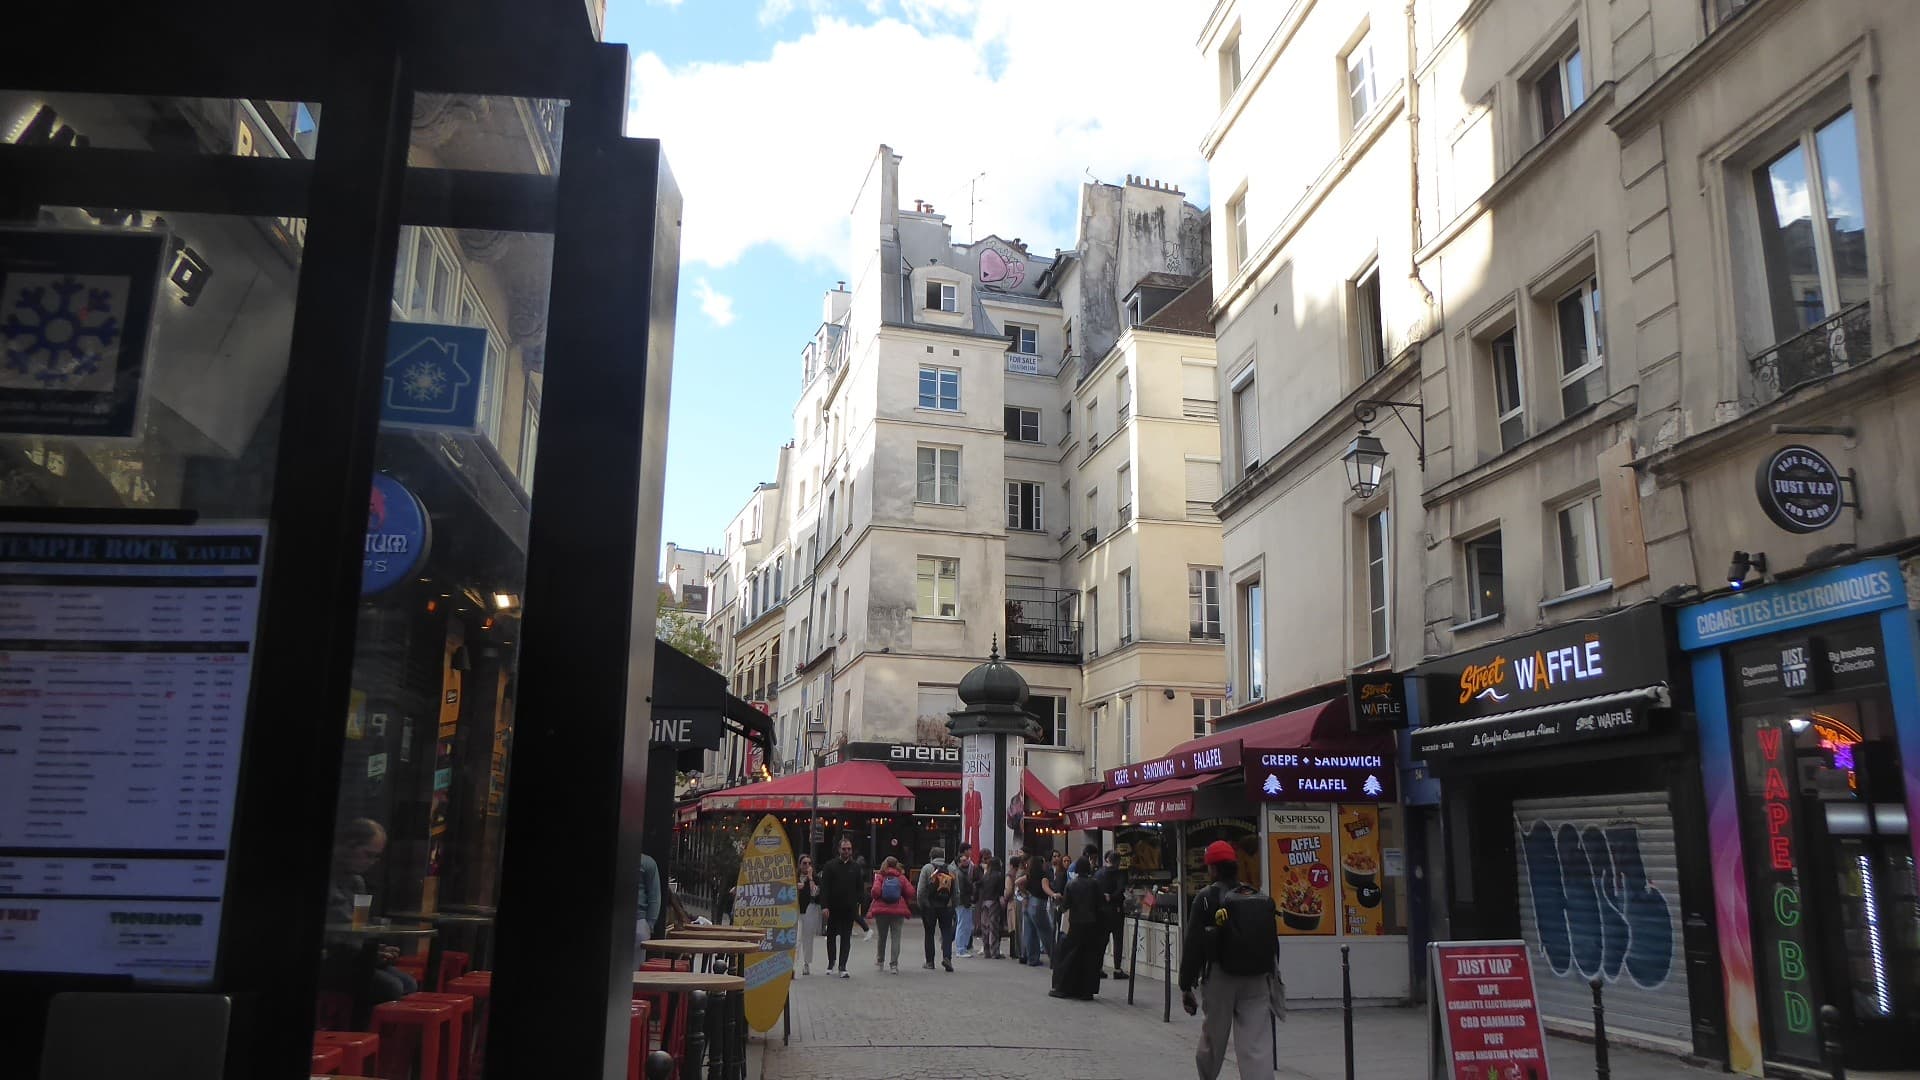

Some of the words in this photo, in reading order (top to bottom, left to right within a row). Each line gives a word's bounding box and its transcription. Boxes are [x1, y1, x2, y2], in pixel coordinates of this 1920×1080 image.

[1778, 456, 1798, 471] VAPE
[1801, 457, 1825, 472] SHOP
[1775, 480, 1804, 493] JUST
[1807, 482, 1834, 494] VAP
[1785, 502, 1803, 516] CBD
[1807, 504, 1829, 518] SHOP
[104, 538, 178, 560] ROCK
[1696, 600, 1772, 634] CIGARETTES
[1773, 570, 1891, 618] ÉLECTRONIQUES
[1782, 647, 1803, 666] JUST
[1459, 656, 1506, 703] Street
[1514, 641, 1603, 691] WAFFLE
[1832, 659, 1874, 673] Collection
[1784, 670, 1807, 687] VAP
[1361, 682, 1392, 699] Street
[1361, 703, 1400, 716] WAFFLE
[1598, 711, 1633, 728] WAFFLE
[891, 745, 959, 761] arena
[1261, 755, 1298, 766] CREPE
[1314, 756, 1381, 767] SANDWICH
[1143, 759, 1175, 780] SANDWICH
[1193, 747, 1223, 770] FALAFEL
[1298, 779, 1348, 790] FALAFEL
[1757, 728, 1793, 871] VAPE
[1133, 801, 1156, 816] FALAFEL
[1274, 814, 1325, 825] NESPRESSO
[744, 854, 792, 872] HAPPY
[1289, 852, 1318, 866] BOWL
[747, 867, 794, 883] HOUR
[737, 884, 771, 897] PINTE
[734, 907, 779, 918] COCKTAIL
[1457, 960, 1486, 975] JUST
[1488, 959, 1512, 974] VAP
[1774, 887, 1812, 1033] CBD
[1477, 984, 1499, 995] VAPE
[1448, 1000, 1483, 1009] CIGARETTE
[1460, 1017, 1479, 1028] CBD
[1480, 1015, 1526, 1028] CANNABIS
[1484, 1033, 1504, 1045] PUFF
